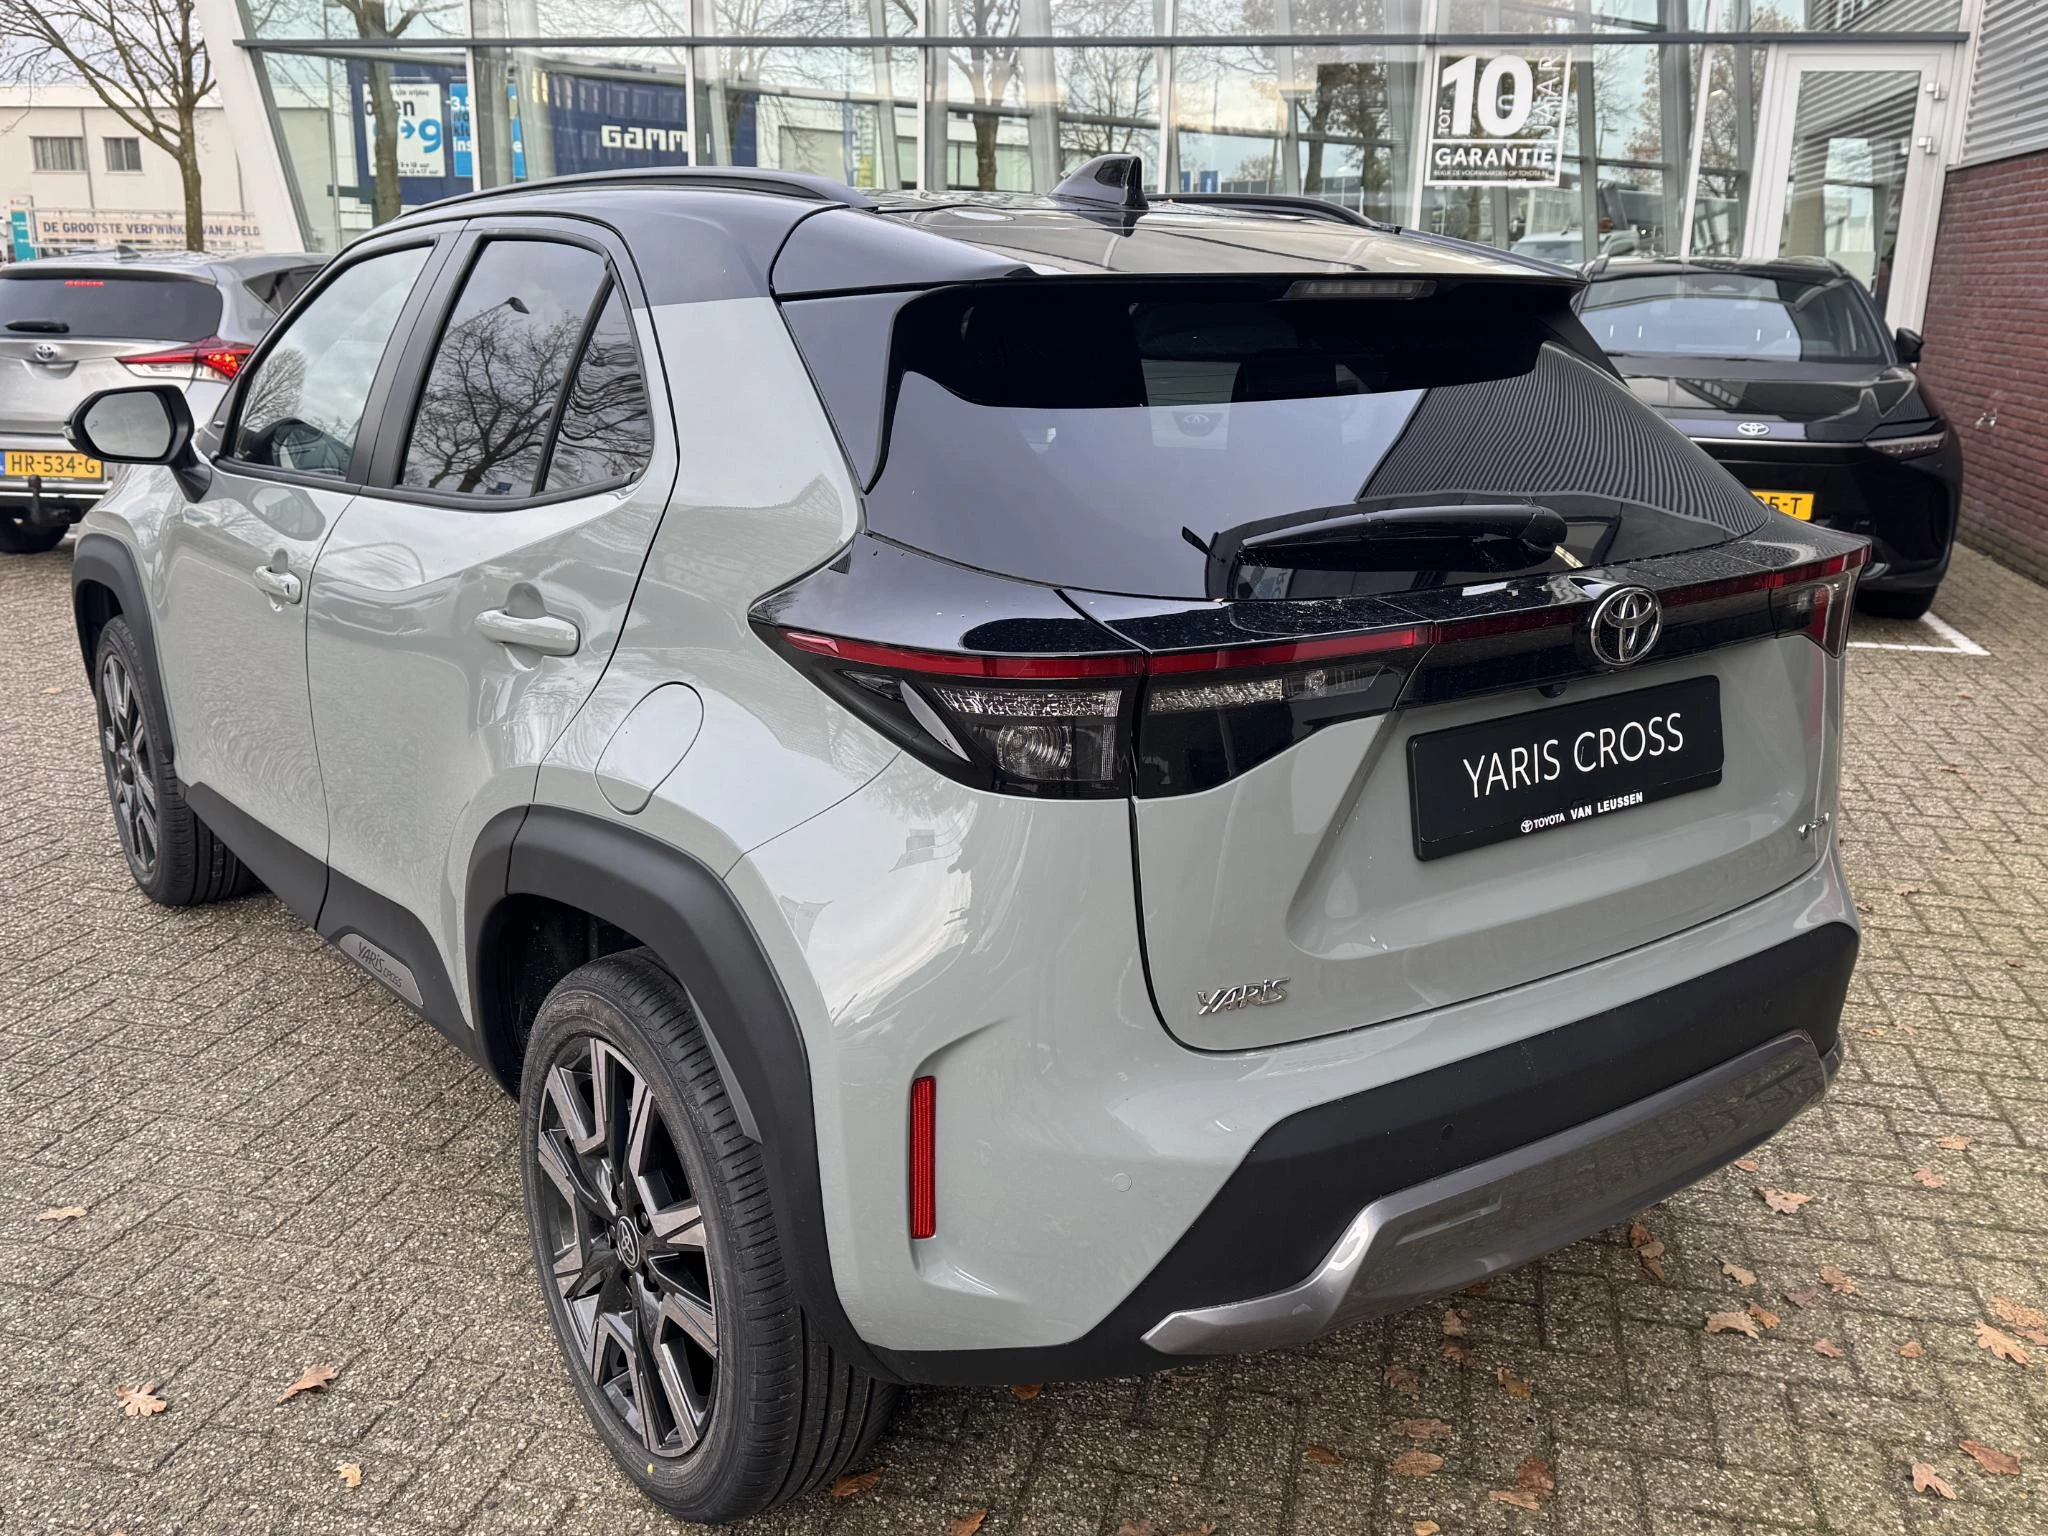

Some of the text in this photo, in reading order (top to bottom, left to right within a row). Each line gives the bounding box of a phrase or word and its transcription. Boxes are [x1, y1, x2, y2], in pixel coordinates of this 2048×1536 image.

[365, 101, 415, 116] oen
[1441, 54, 1534, 137] 10
[1532, 54, 1562, 136] JAAR
[1437, 107, 1451, 135] TOT
[418, 118, 442, 154] 9
[1435, 147, 1553, 168] GARANTIE
[43, 221, 59, 233] DE
[62, 222, 123, 234] GROOTSTE
[126, 223, 185, 235] VERFWINK
[11, 454, 96, 474] HR-534-G
[1755, 495, 1803, 515] 5-T
[1463, 712, 1684, 798] YARIS CROSS
[1534, 791, 1643, 829] TOYOTA VAN LEUSSEN
